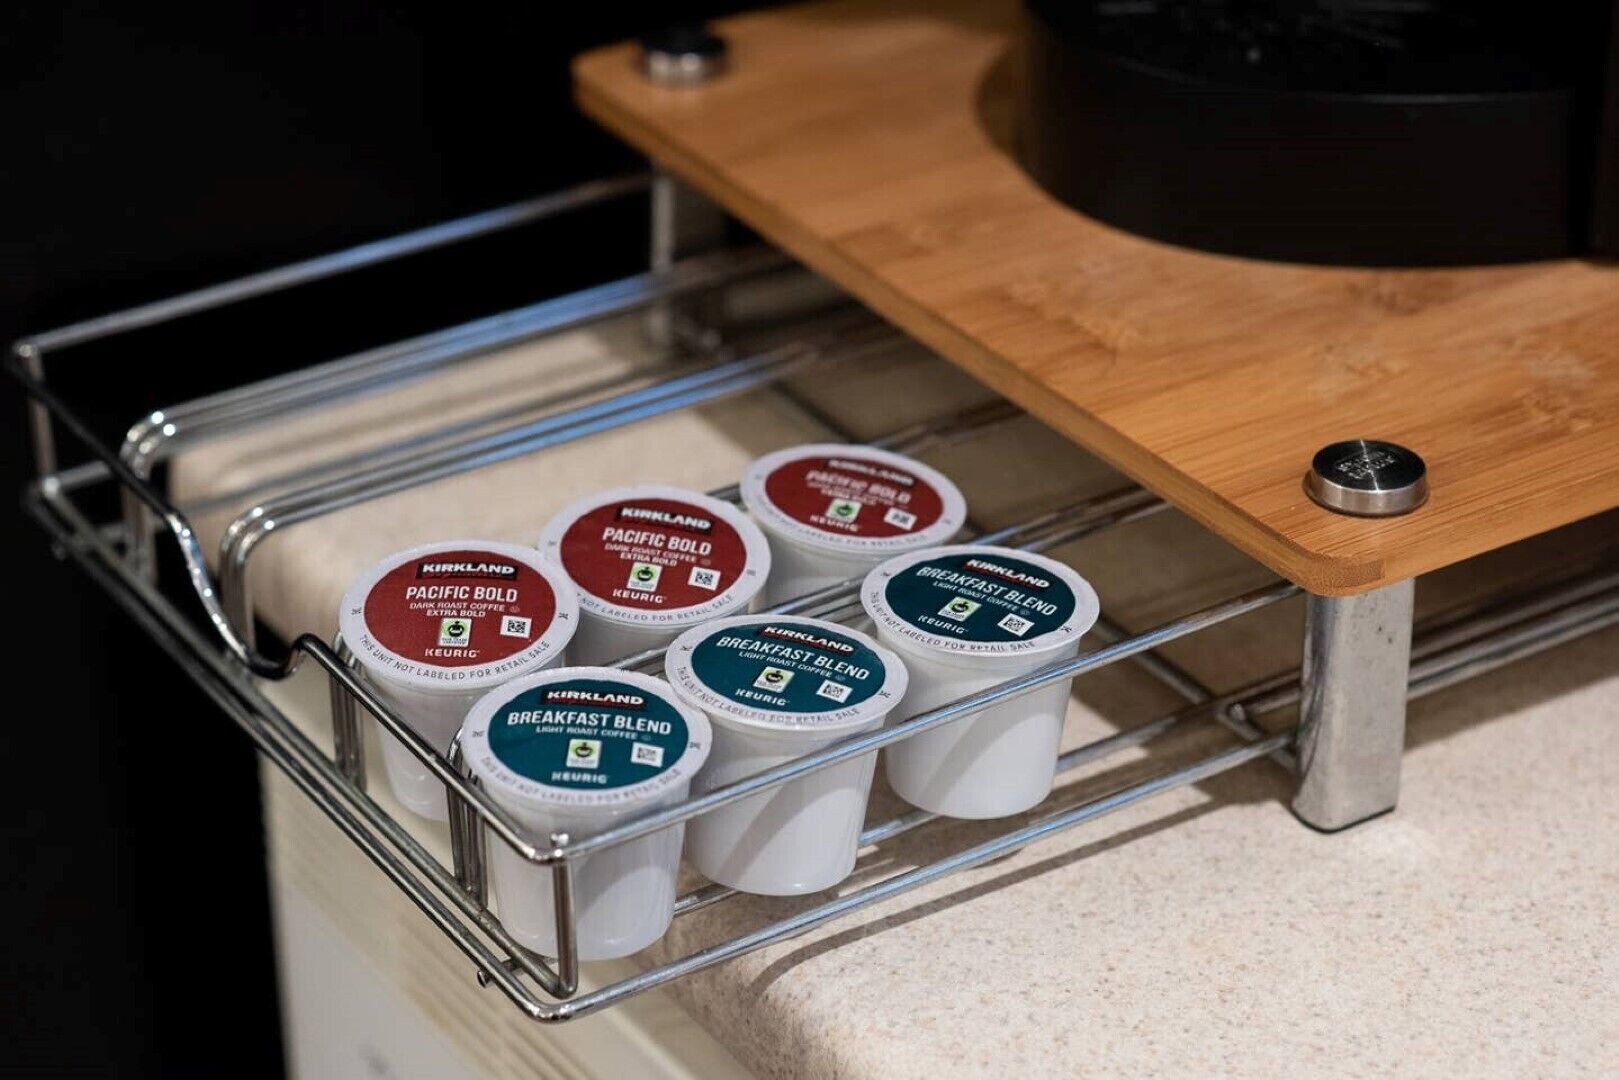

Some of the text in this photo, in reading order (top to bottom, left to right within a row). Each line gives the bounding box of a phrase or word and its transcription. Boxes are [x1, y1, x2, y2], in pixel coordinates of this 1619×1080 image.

[621, 507, 711, 529] KIRKLAND
[602, 527, 713, 556] PACIFIC BOLD
[620, 552, 677, 566] EXTRA BOLD
[663, 550, 696, 562] COFFEE
[422, 563, 516, 576] KIRKLAND
[966, 558, 1050, 588] KIRKLAND
[406, 585, 518, 603] PACIFIC BOLD
[612, 589, 663, 604] KEURIG
[917, 566, 1058, 616] BREAKFAST BLEND
[933, 581, 1018, 611] LIGHT ROAST COFFEE
[409, 602, 506, 612] DARK ROAST COFFEE
[426, 609, 486, 618] EXTRA BOLD
[918, 614, 966, 634] KEURIG
[764, 626, 855, 652] KIRKLAND
[899, 625, 941, 646] LABELED
[944, 641, 966, 650] FOR
[1010, 641, 1036, 651] SALE
[360, 634, 551, 681] THIS UNIT NOT LABELED FOR RETAIL SALE
[424, 648, 478, 658] KEURIG
[716, 636, 870, 680] BREAKFAST BLEND
[739, 651, 832, 677] LIGHT ROAST COFFEE
[547, 690, 645, 705] KIRKLAND
[735, 688, 788, 706] KEURIG
[719, 702, 766, 721] LABELED
[507, 710, 672, 736] BREAKFAST BLEND
[536, 725, 638, 741] LIGHT ROAST COFFEE
[551, 771, 607, 785] KEURIG
